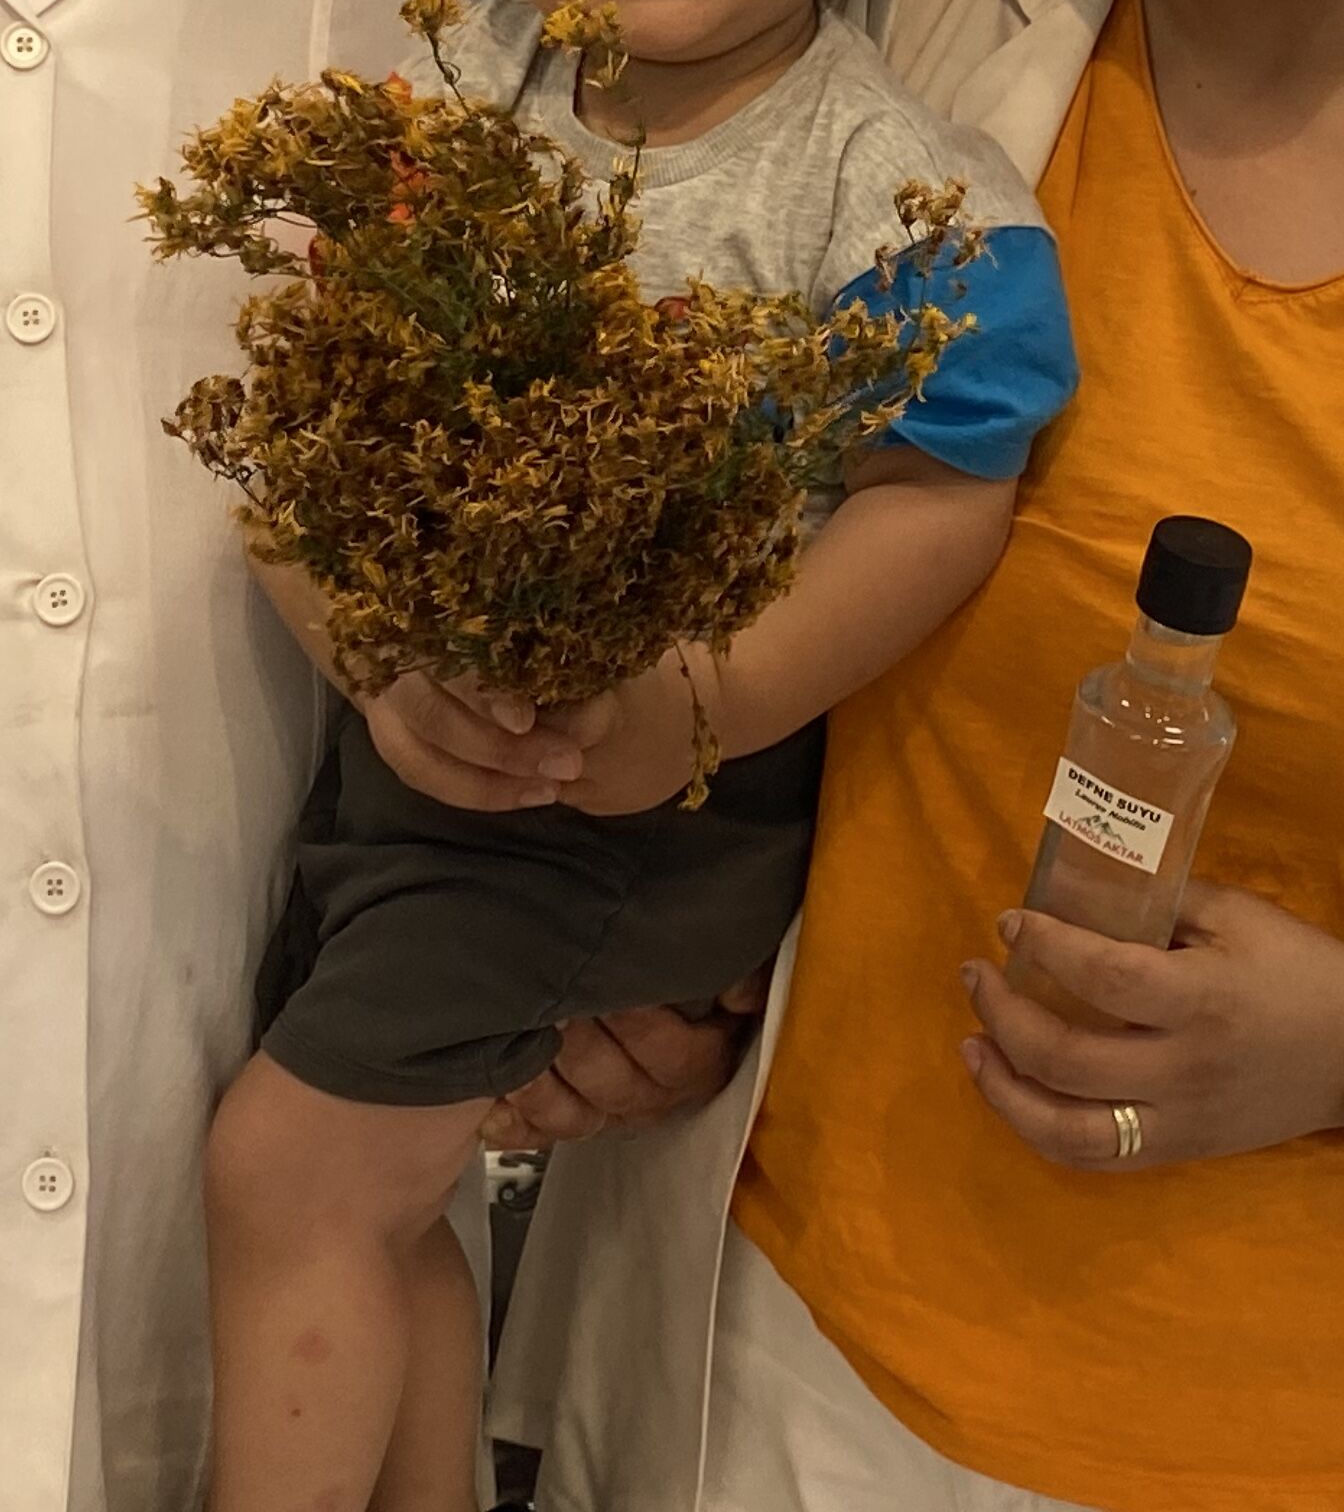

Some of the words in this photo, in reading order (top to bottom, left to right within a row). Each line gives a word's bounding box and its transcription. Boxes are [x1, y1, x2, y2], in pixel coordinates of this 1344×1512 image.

[1067, 767, 1114, 804] DEFNE
[1116, 798, 1162, 824] SUYU
[1105, 838, 1145, 865] AKTAR
